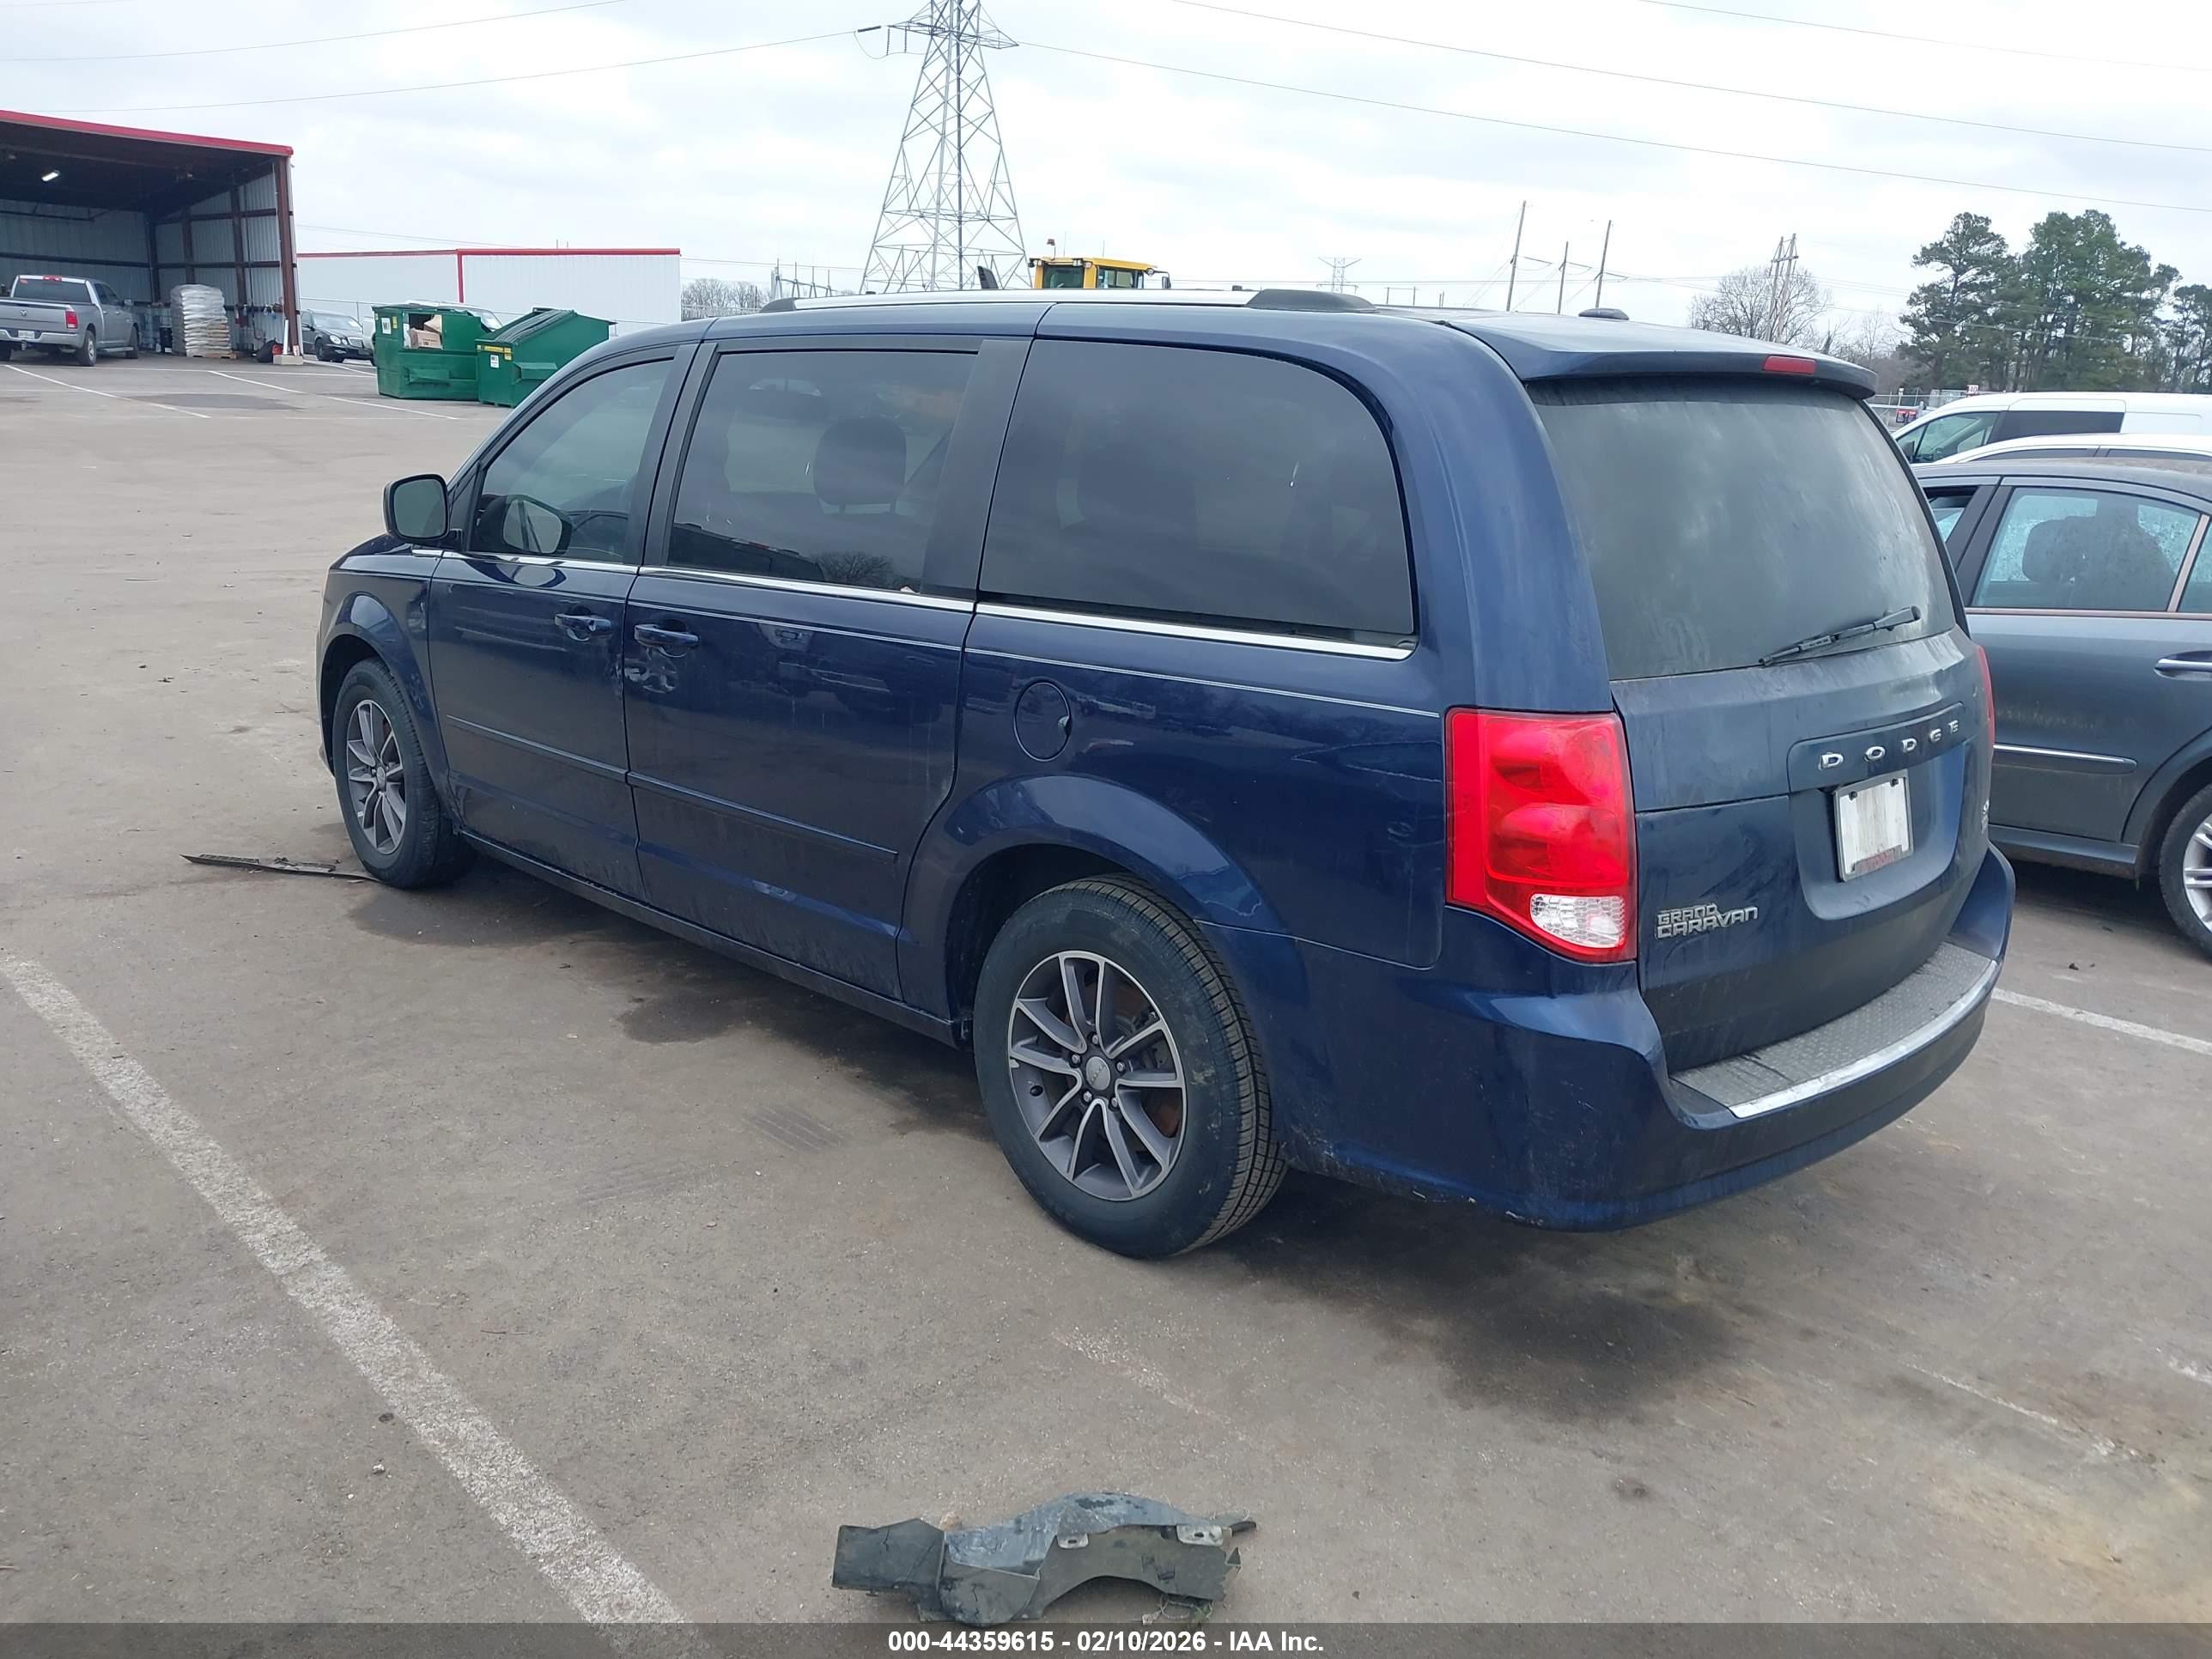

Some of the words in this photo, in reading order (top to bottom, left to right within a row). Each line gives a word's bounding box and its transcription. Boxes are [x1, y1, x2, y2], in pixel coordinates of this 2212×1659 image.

[1819, 720, 1959, 769] DODGE
[1656, 902, 1717, 926] GRAND
[1656, 906, 1759, 939] CARAVAN
